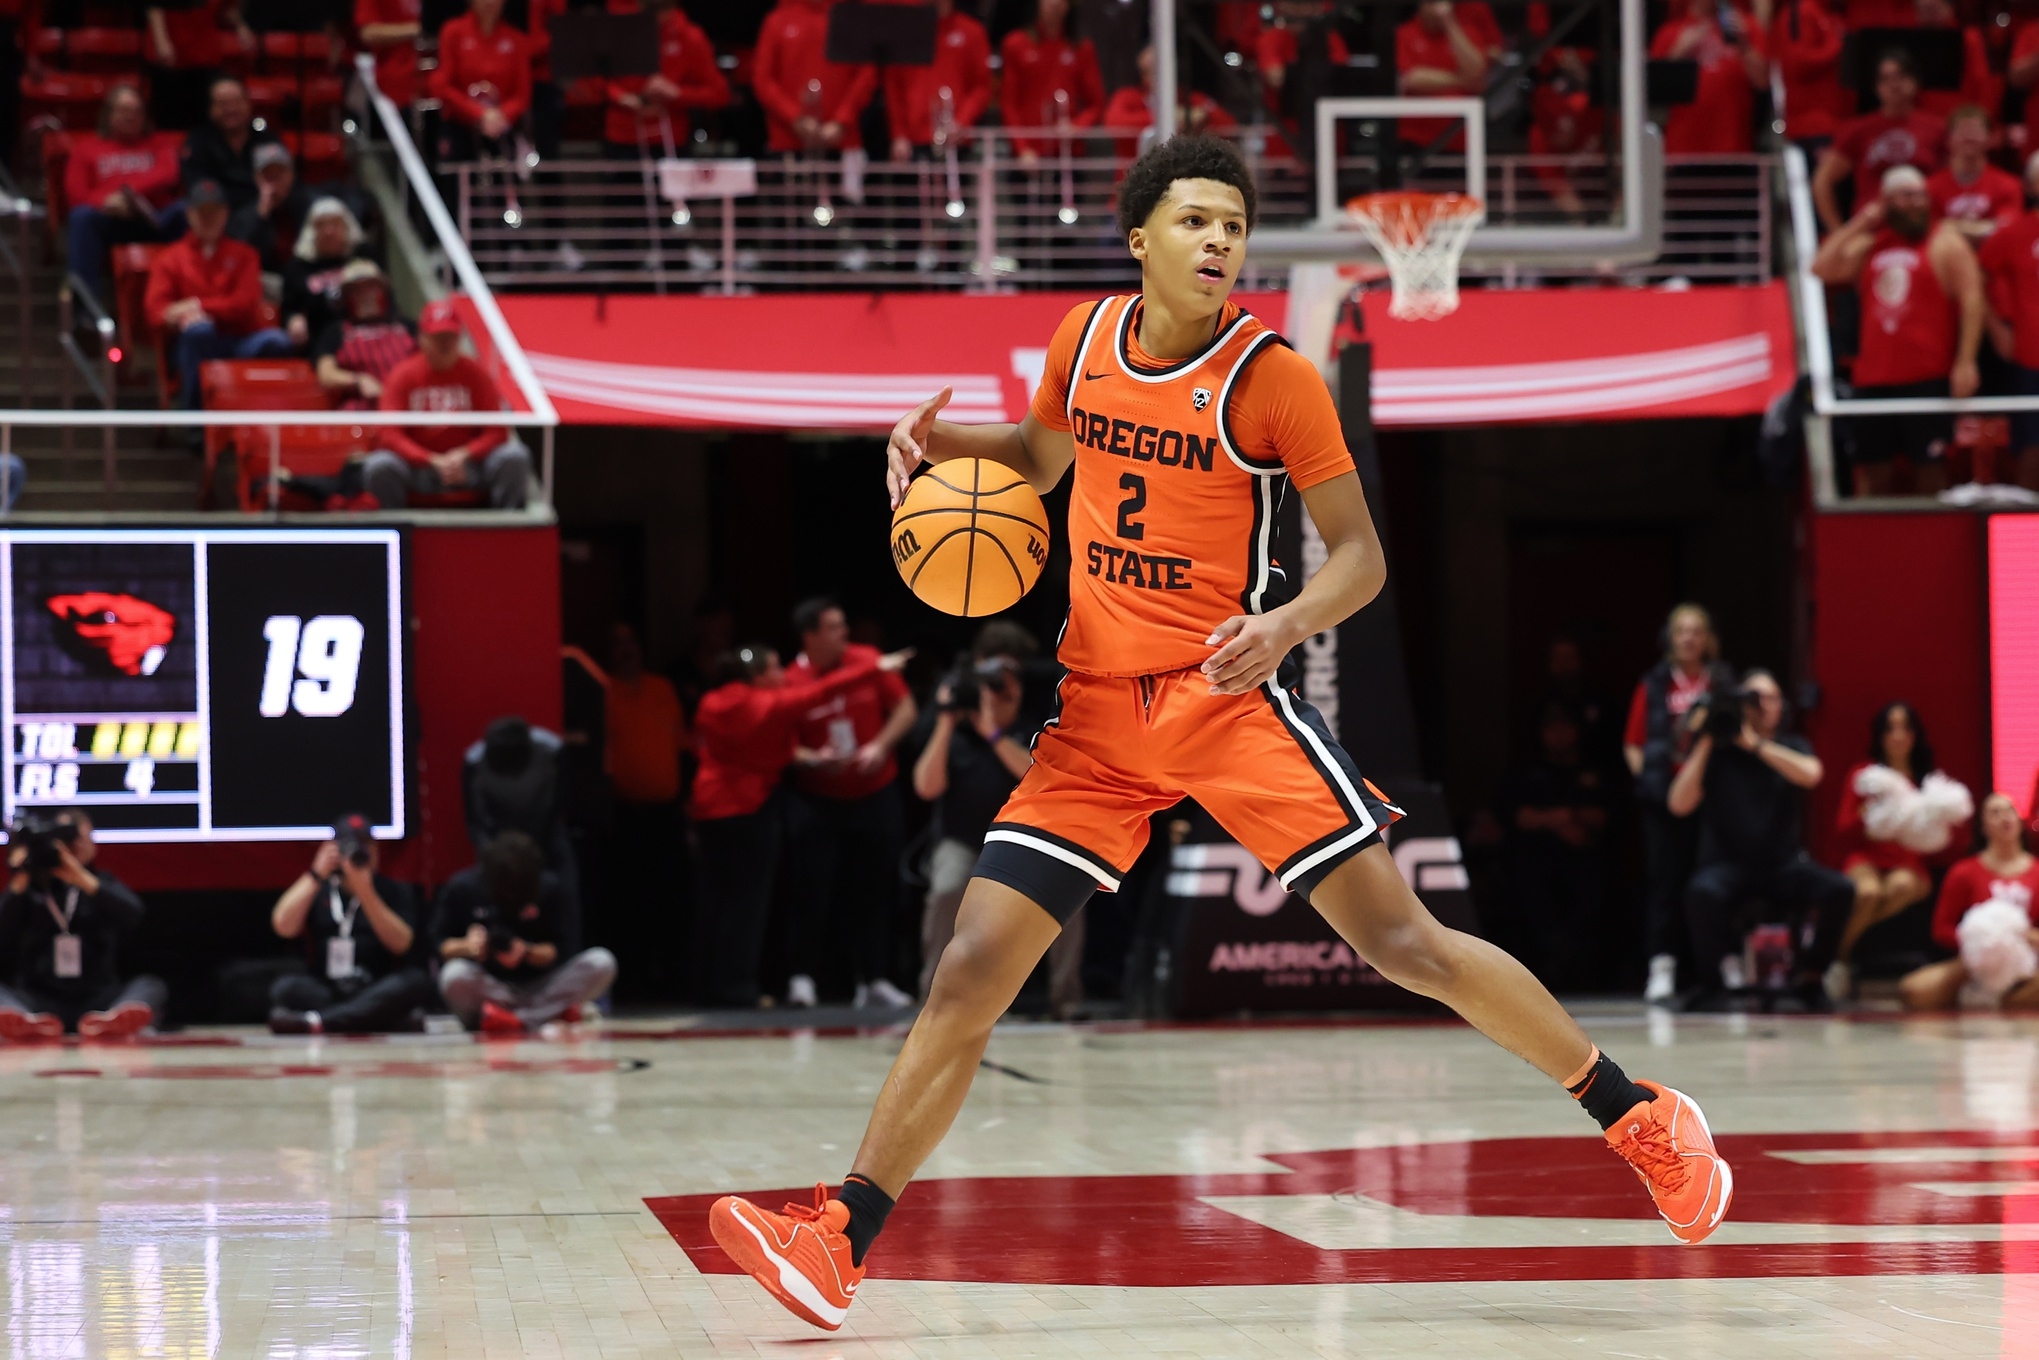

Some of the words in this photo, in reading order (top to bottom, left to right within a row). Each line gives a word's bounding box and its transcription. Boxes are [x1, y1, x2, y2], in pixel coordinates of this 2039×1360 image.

[1073, 407, 1217, 472] OREGON
[1117, 472, 1146, 541] 2
[1087, 540, 1193, 590] STATE
[259, 614, 365, 718] 19
[20, 721, 80, 760] TOL
[20, 762, 81, 799] FLS
[124, 757, 156, 799] 4
